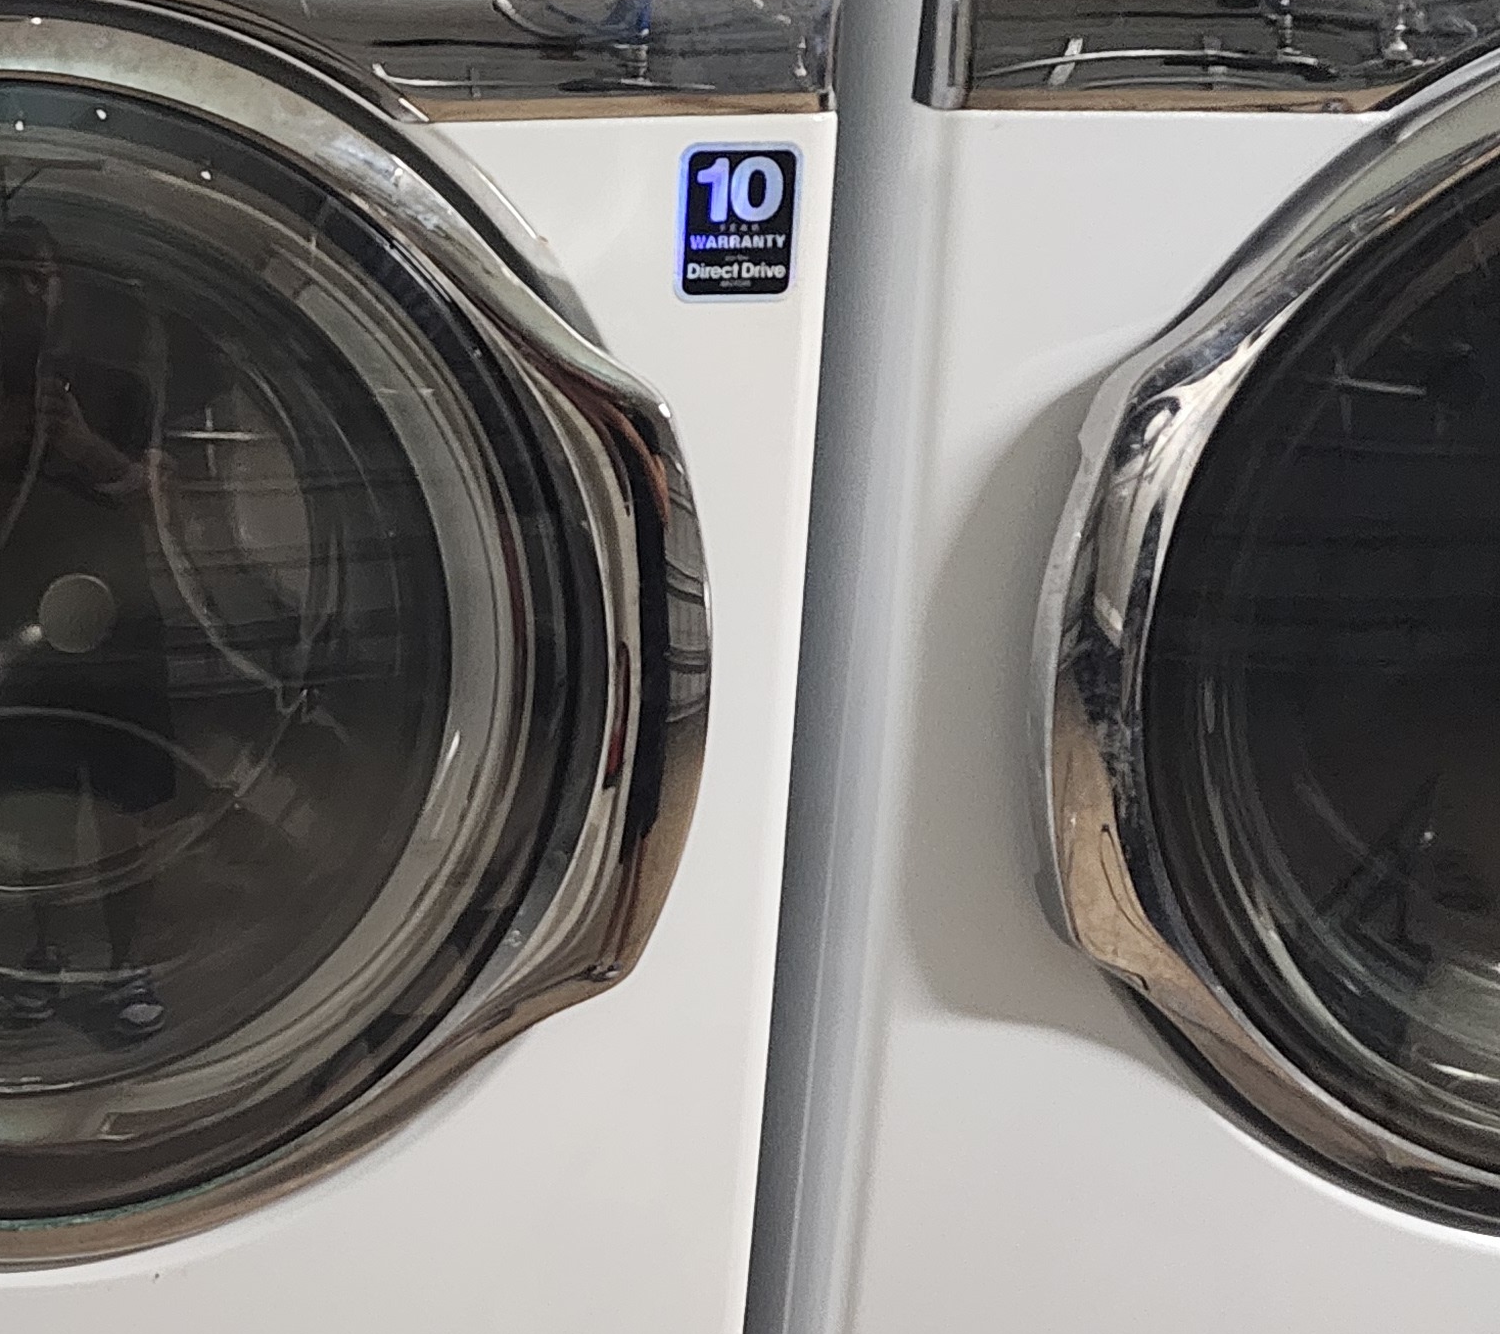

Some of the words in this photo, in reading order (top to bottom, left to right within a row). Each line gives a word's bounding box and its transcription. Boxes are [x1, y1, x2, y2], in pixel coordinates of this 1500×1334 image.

[696, 155, 784, 223] 10
[689, 234, 786, 251] WARRANTY
[686, 262, 740, 280] Direct
[741, 261, 787, 279] Drive
